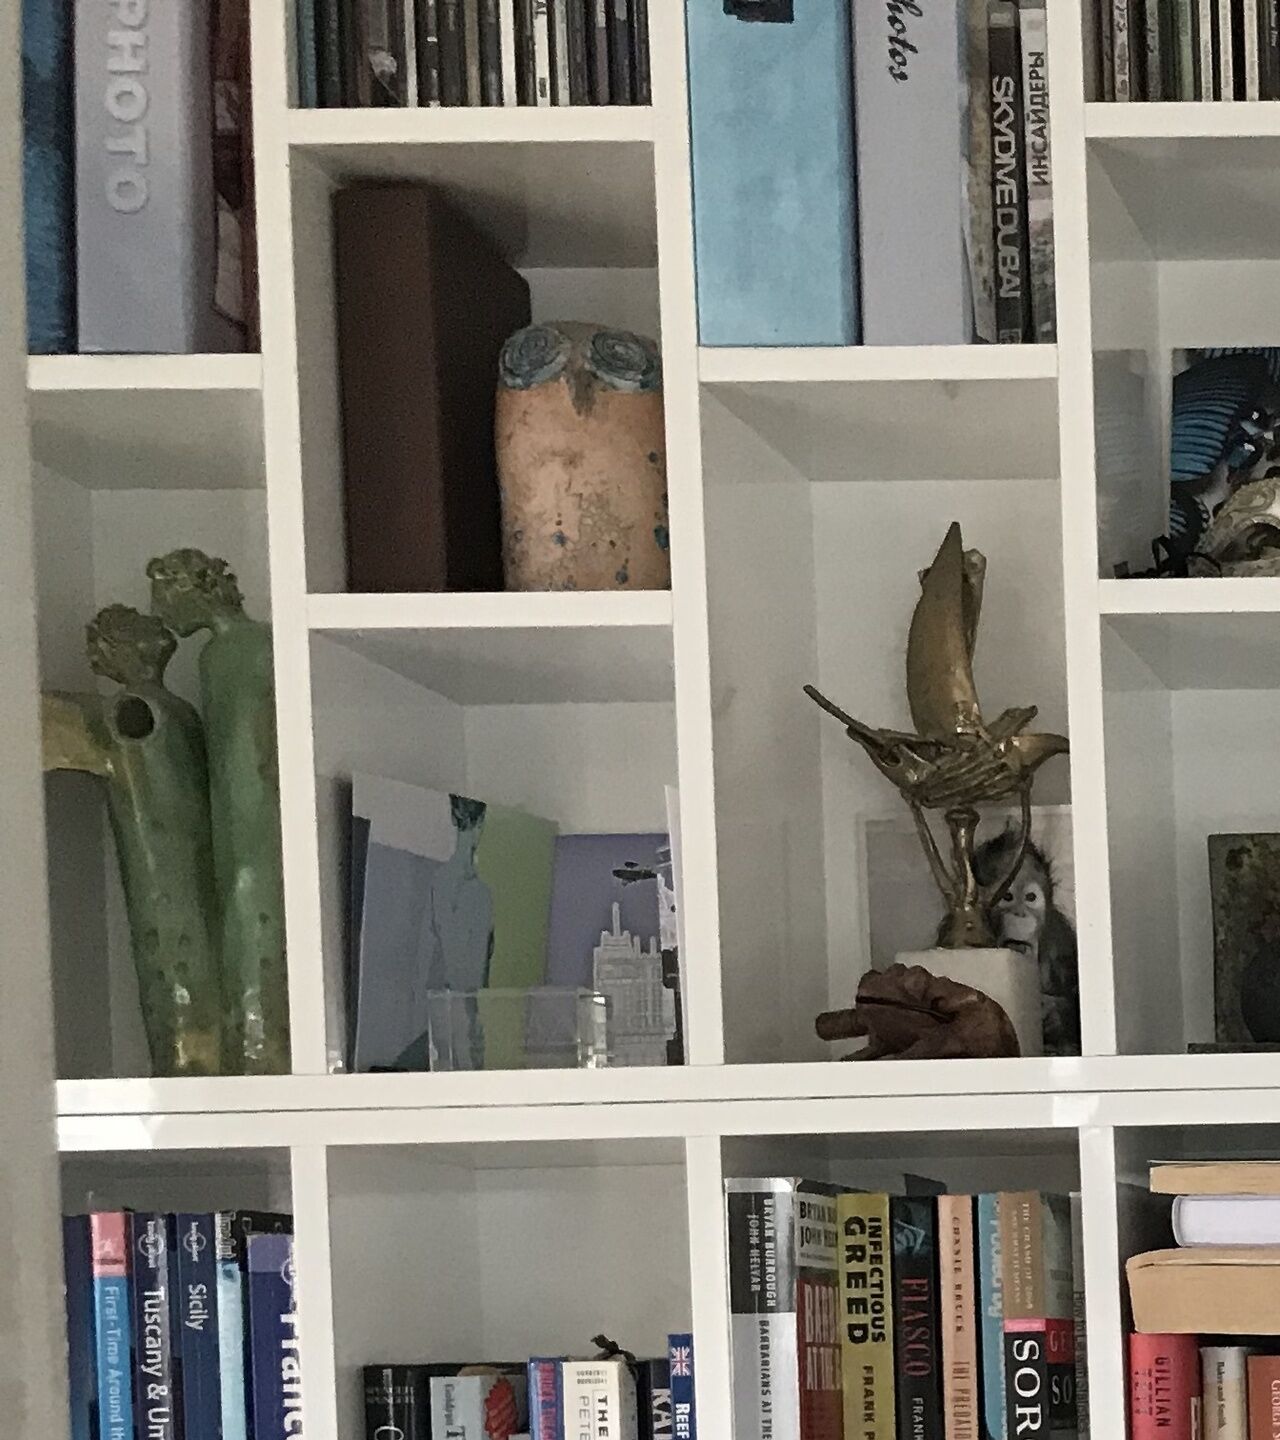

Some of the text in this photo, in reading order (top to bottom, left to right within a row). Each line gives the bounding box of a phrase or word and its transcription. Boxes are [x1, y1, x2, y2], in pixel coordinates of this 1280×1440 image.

[1029, 52, 1048, 185] ИНСАЙДЕРЫ
[992, 75, 1021, 298] SKYDIVE DUBAI
[185, 1284, 208, 1331] Sicily
[844, 1216, 868, 1345] GREED
[867, 1216, 886, 1344] INFECTIOUS
[900, 1276, 930, 1377] FIASCO
[141, 1286, 165, 1380] Tuscany
[151, 1384, 169, 1400] &
[597, 1395, 608, 1438] THE
[862, 1365, 876, 1424] FRANK
